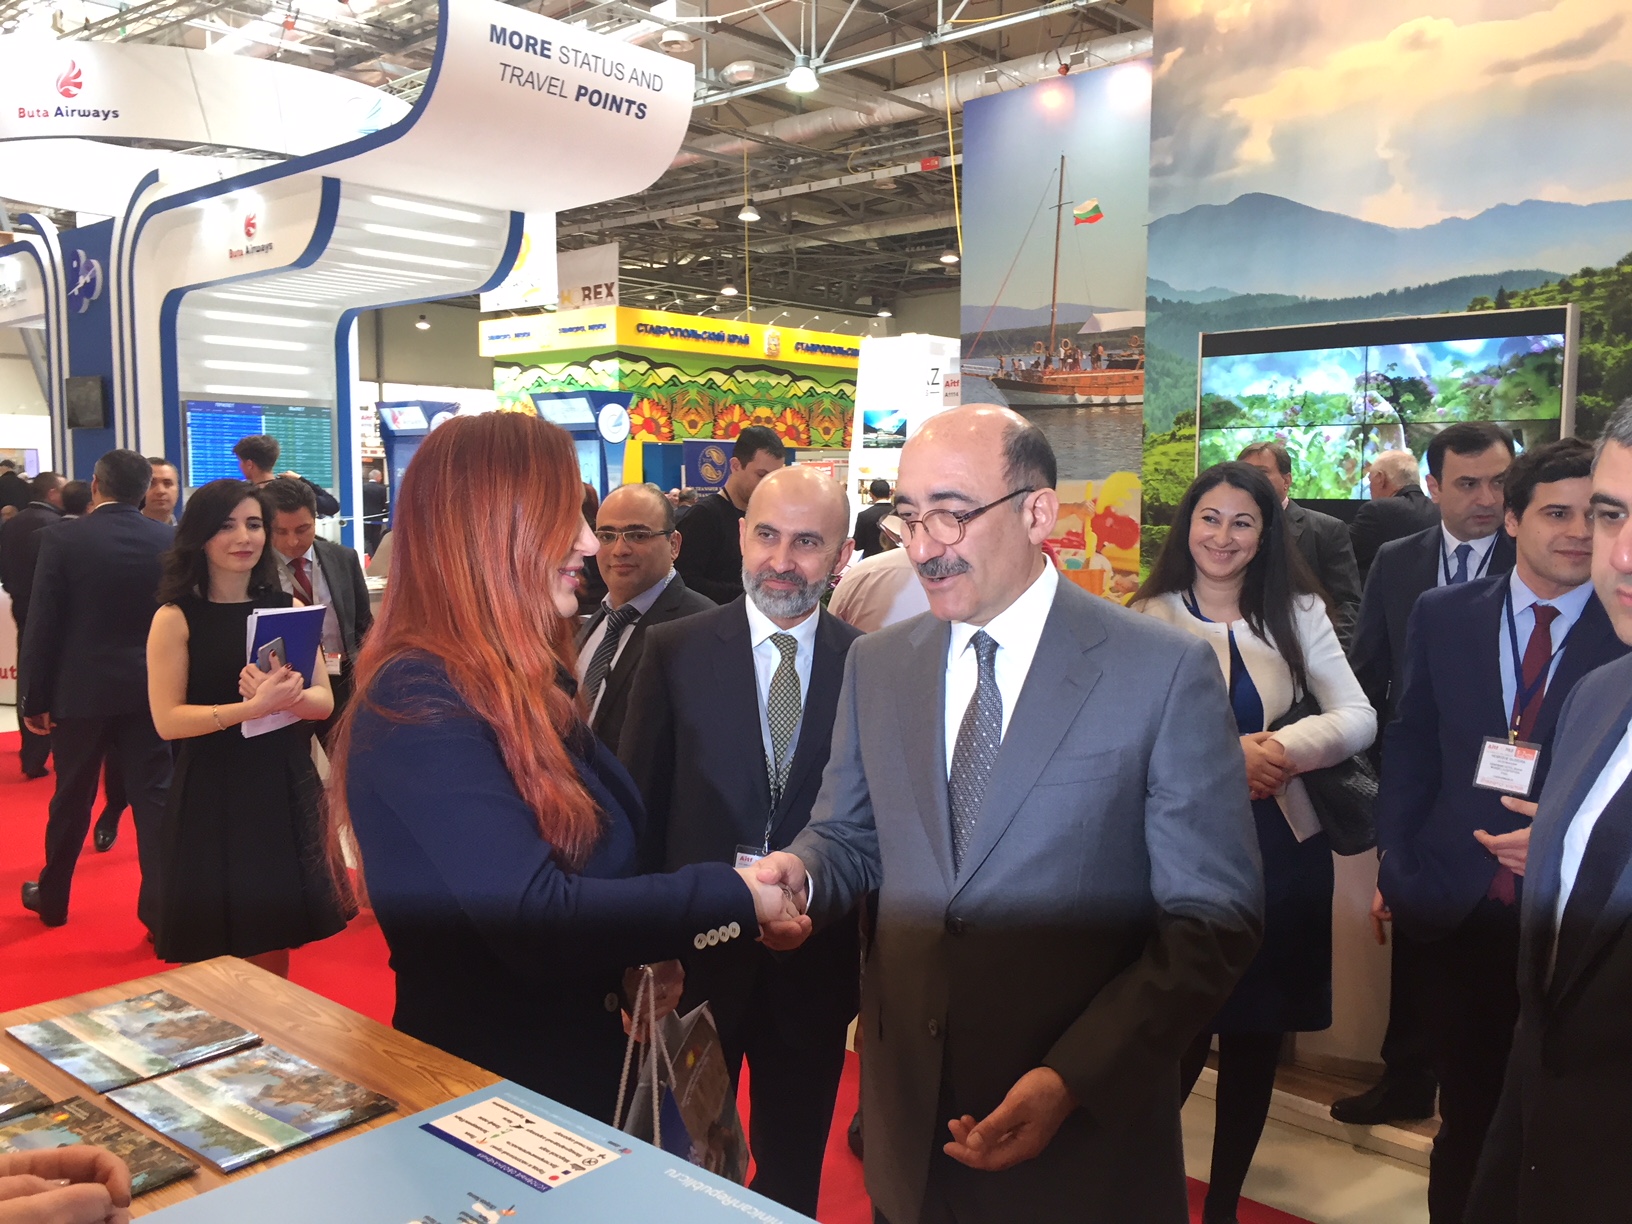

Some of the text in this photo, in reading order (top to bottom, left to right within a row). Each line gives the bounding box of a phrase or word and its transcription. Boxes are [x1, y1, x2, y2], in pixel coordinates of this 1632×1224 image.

[489, 23, 664, 92] MORE STATUS AND
[499, 62, 648, 120] TRAVEL POINTS
[18, 106, 120, 121] Buta Airways
[945, 379, 960, 387] Aitf
